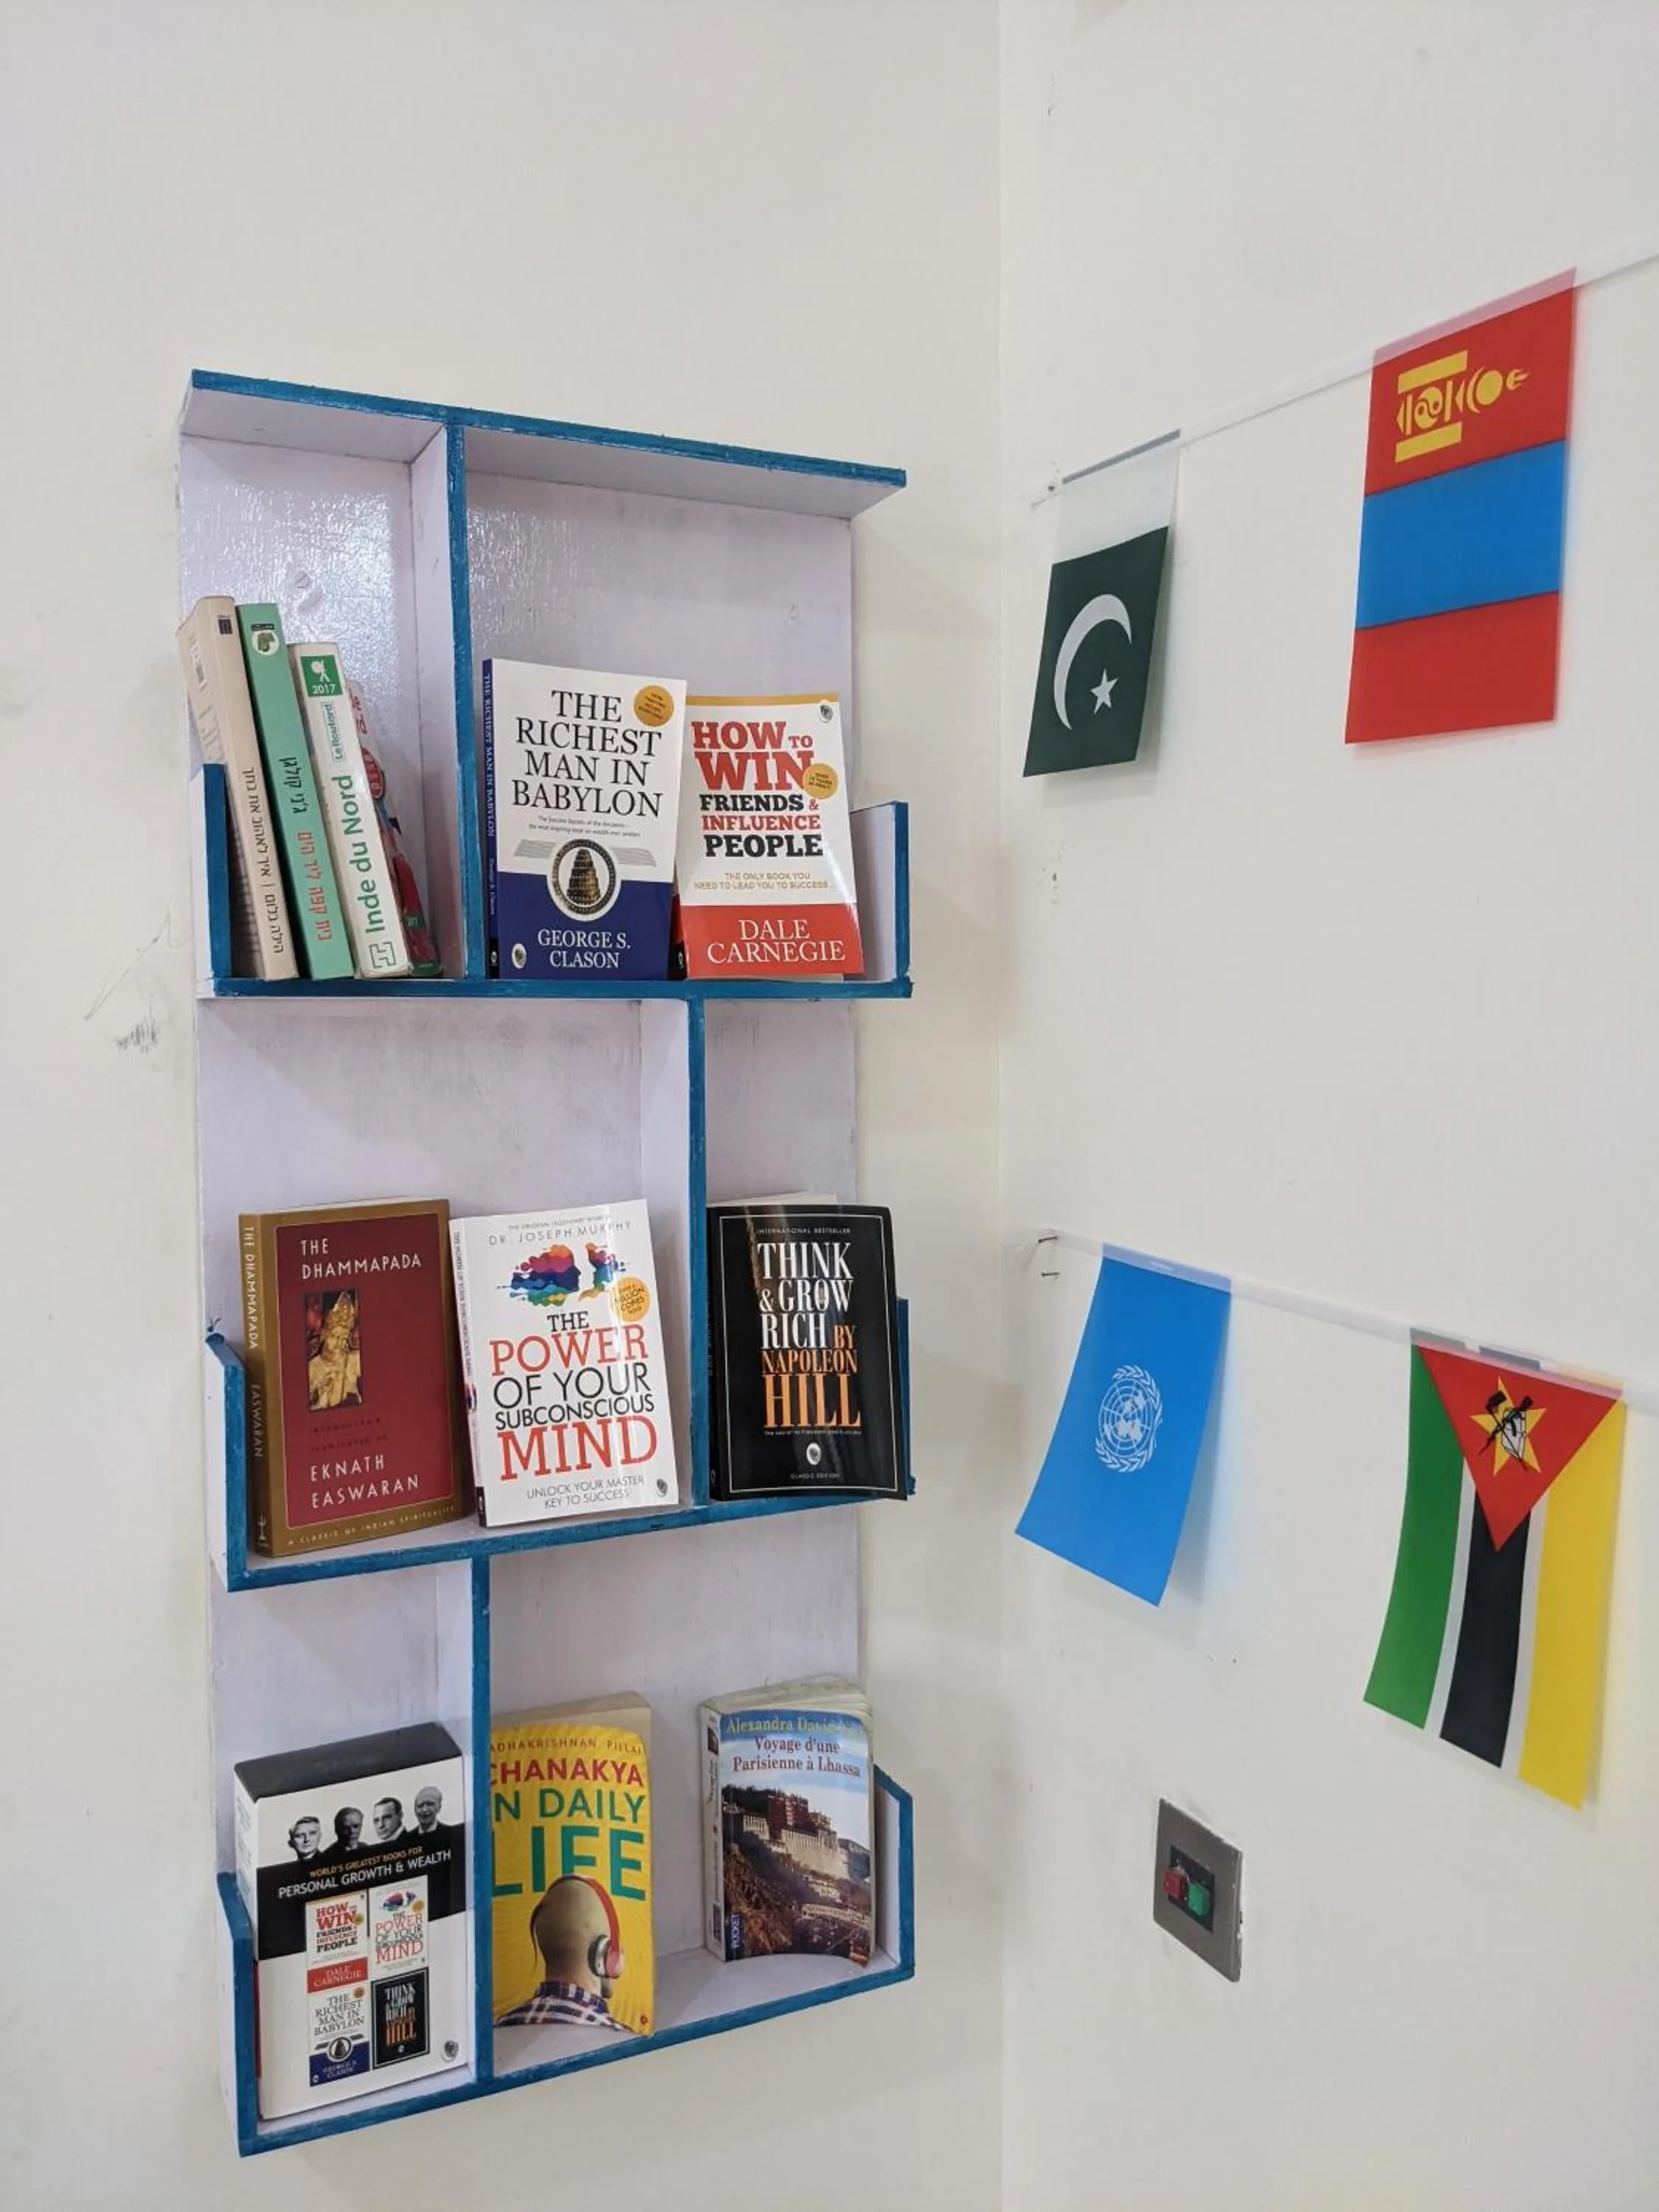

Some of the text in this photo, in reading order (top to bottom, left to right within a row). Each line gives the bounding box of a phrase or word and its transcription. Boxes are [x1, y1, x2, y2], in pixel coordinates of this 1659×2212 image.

[312, 684, 335, 694] 2017
[551, 689, 622, 723] THE
[516, 717, 662, 757] RICHEST
[691, 721, 813, 750] HOW TO
[524, 749, 650, 787] MAN IN
[695, 750, 814, 791] WIN
[248, 795, 260, 813] את
[512, 779, 664, 818] BABYLON
[699, 794, 819, 812] FRIENDS &
[701, 815, 821, 831] INFLUENCE
[332, 775, 385, 933] Inde du Nord
[703, 834, 824, 858] PEOPLE
[695, 881, 828, 890] NEED TO LEAD YOU TO SUCCESS
[538, 929, 631, 950] GEORGE S.
[738, 919, 810, 940] DALE
[549, 950, 620, 969] CLASON
[707, 940, 846, 964] CARNEGIE
[519, 1228, 572, 1243] JOSEPH
[577, 1221, 631, 1237] MURPHY
[301, 1238, 329, 1256] THE
[302, 1253, 422, 1279] DHAMMAPADA
[757, 1242, 855, 1280] THINK
[244, 1227, 258, 1349] THE DHAMMAPADA
[759, 1279, 854, 1312] & GROW
[546, 1310, 589, 1332] THE
[760, 1312, 857, 1349] RICH BY
[490, 1323, 649, 1377] POWER
[761, 1349, 858, 1374] NAPOLEON
[493, 1362, 652, 1410] OF YOUR
[495, 1393, 655, 1431] SUBCONSCIOUS
[762, 1374, 862, 1428] HILL
[497, 1414, 658, 1481] MIND
[310, 1454, 385, 1482] EKNATH
[311, 1474, 419, 1509] EASWARAN
[526, 1475, 645, 1500] UNLOCK YOUR MASTER
[544, 1489, 631, 1509] KEY TO SUCCESS
[727, 1717, 793, 1733] Alexandra
[490, 1737, 642, 1756] ADHAKRISHNAN PILLAI
[754, 1735, 841, 1754] Voyage d'une
[733, 1755, 861, 1778] Parisienne à Lhassa
[494, 1787, 647, 1824] N DAILY
[278, 1848, 452, 1899] PERSONAL GROWTH & WEALTH
[310, 1846, 423, 1878] WORLD'S GREATEST BOOKS FOR
[491, 1825, 647, 1902] LIFE
[316, 1902, 349, 1917] HOW
[317, 1910, 355, 1930] WIN
[316, 1936, 358, 1953] PEOPLE
[376, 1940, 424, 1964] MIND
[315, 1999, 364, 2017] RICHEST
[327, 1994, 350, 2007] THE
[314, 2015, 364, 2036] BABYLON
[347, 2009, 360, 2019] IN
